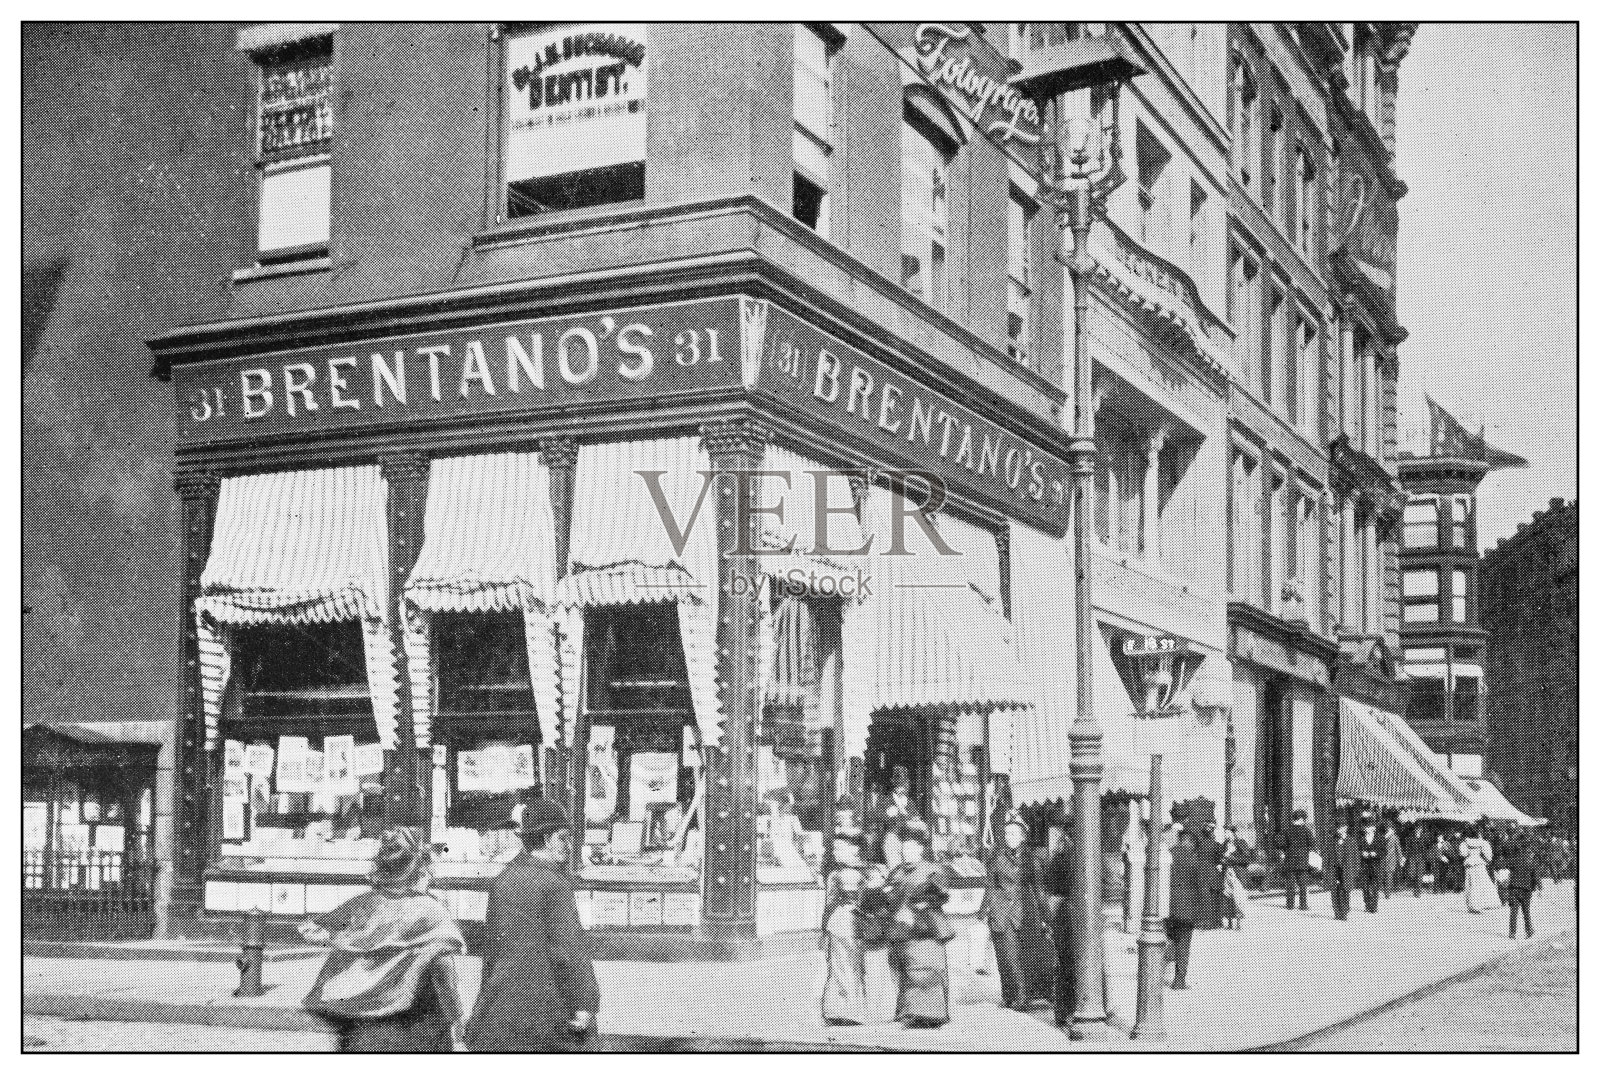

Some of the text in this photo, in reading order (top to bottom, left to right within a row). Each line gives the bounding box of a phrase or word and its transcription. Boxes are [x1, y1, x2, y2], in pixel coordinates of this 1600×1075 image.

[190, 316, 722, 421] 31 BRENTANO'S 31
[777, 341, 1046, 501] 31 BRENTANO'S
